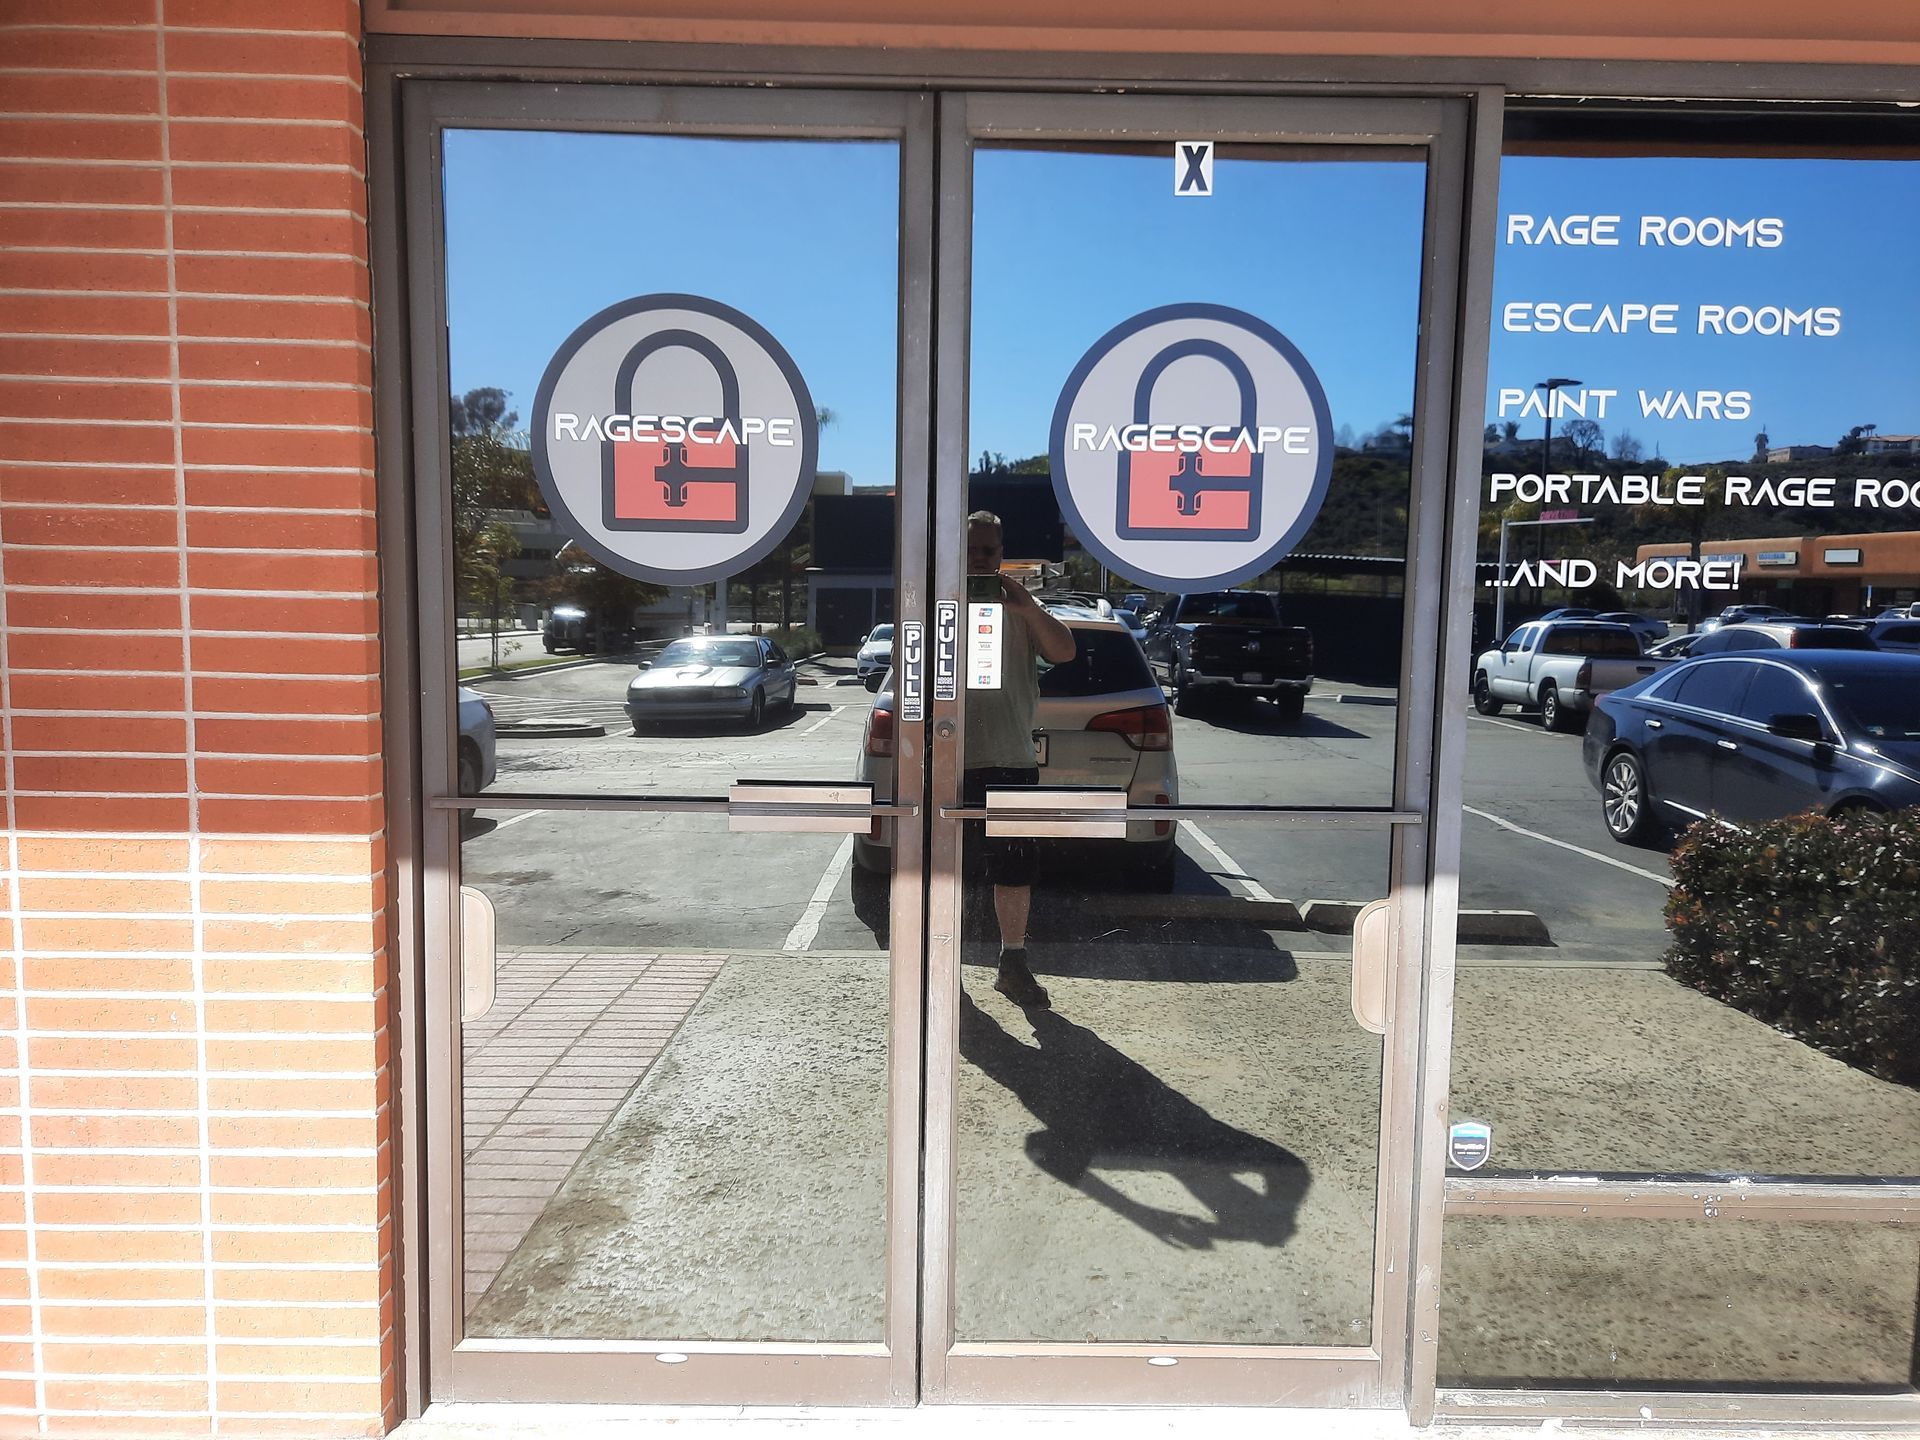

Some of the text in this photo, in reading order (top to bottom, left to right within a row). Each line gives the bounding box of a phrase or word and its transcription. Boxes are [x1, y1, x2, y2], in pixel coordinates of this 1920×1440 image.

[1178, 145, 1209, 192] X
[1506, 214, 1784, 248] RAGE ROOMS
[1502, 302, 1842, 337] ESCAPE ROOMS
[1497, 388, 1752, 420] PAINT WARS
[554, 412, 795, 447] RAGESCAPE
[1072, 422, 1311, 455] RAGESCAPE
[1489, 473, 1706, 505] PORTABLE
[1724, 476, 1837, 508] RAGE
[1484, 560, 1597, 589] ...AND
[1616, 560, 1742, 591] MORE!
[938, 609, 955, 676] PULL
[905, 630, 921, 697] PULL
